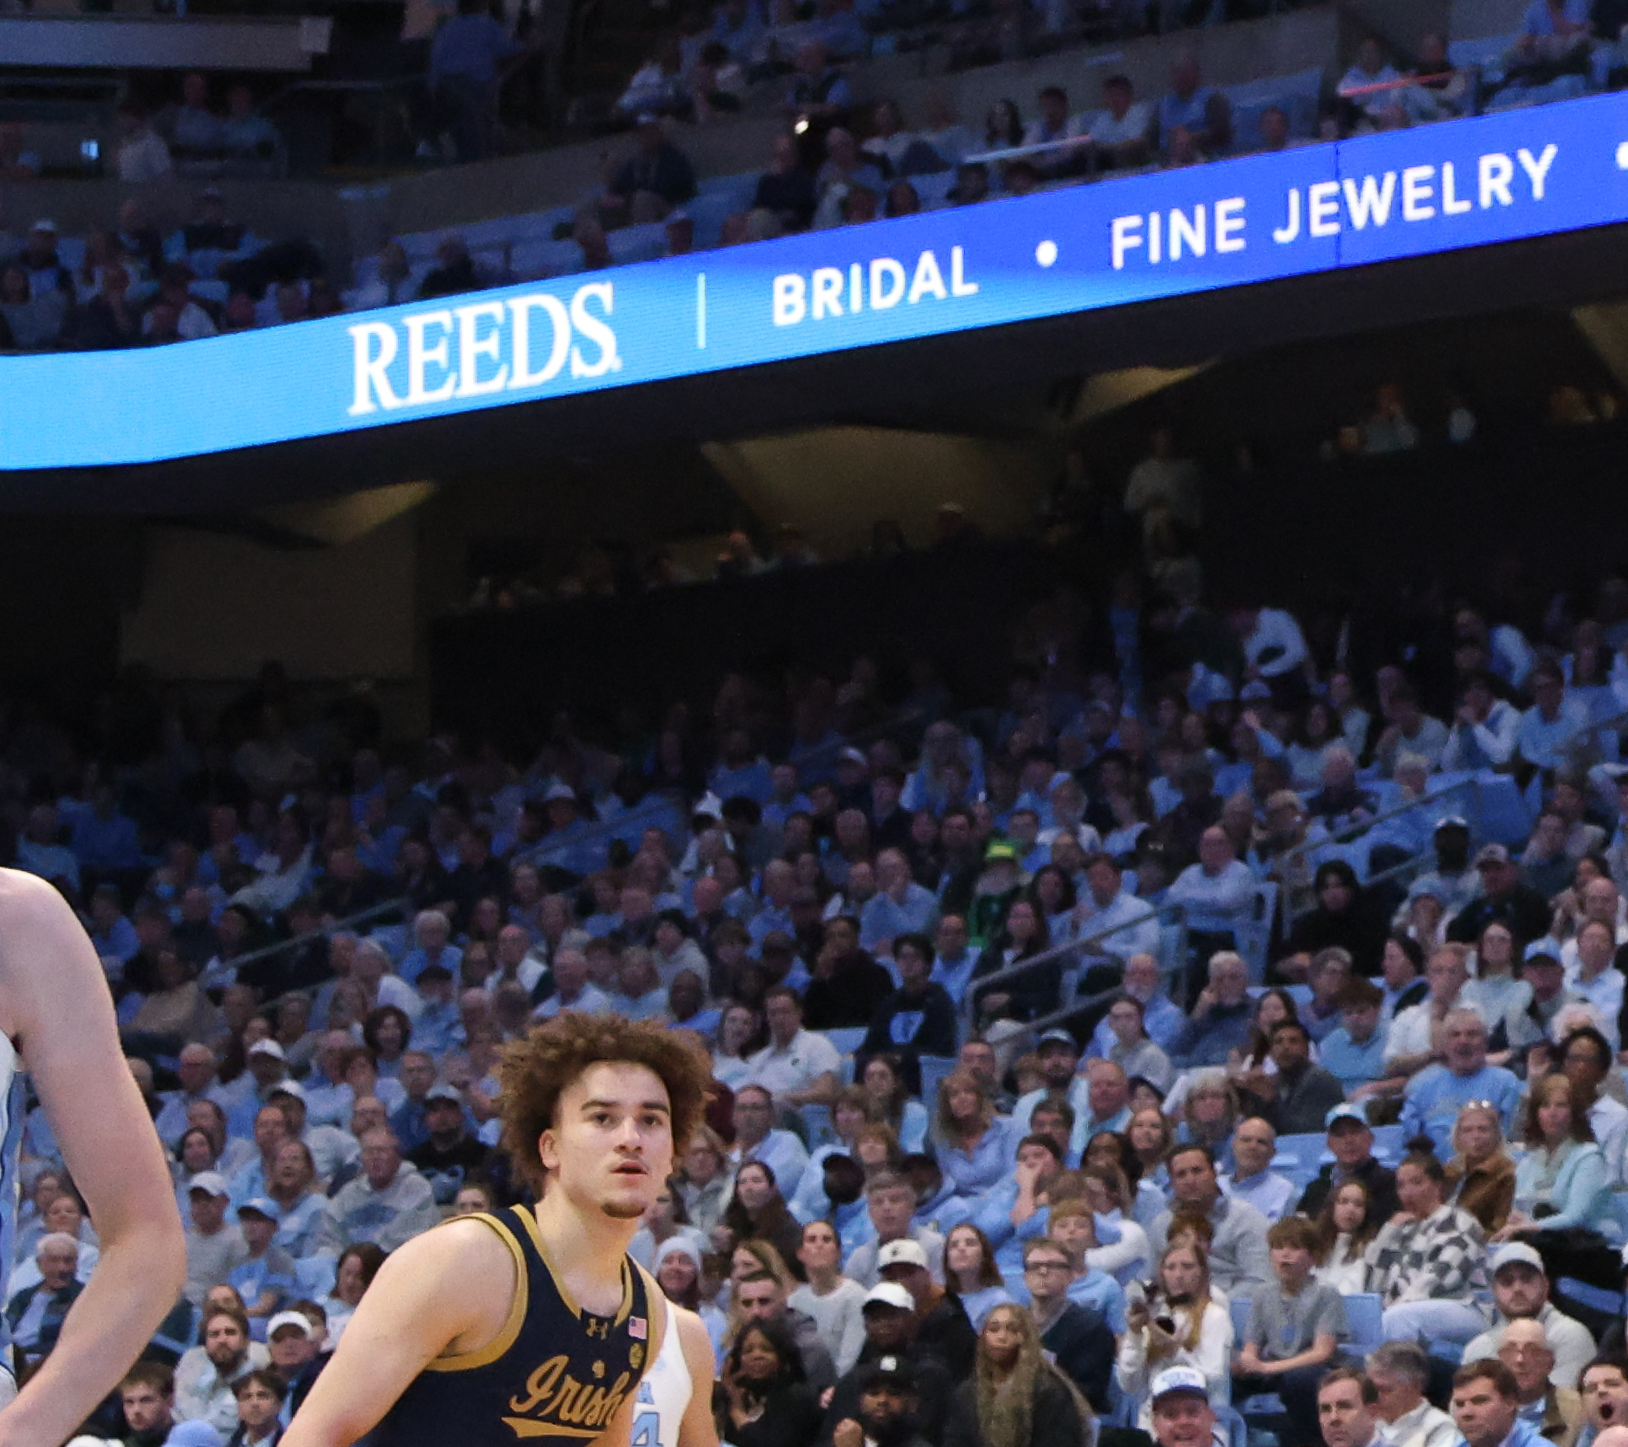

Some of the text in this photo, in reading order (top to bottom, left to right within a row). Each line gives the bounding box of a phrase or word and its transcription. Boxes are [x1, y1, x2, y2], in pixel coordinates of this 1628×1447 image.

[1110, 197, 1246, 271] FINE
[1273, 145, 1558, 246] JEWELRY
[347, 246, 979, 417] REEDS BRIDAL
[509, 1355, 630, 1427] Irish
